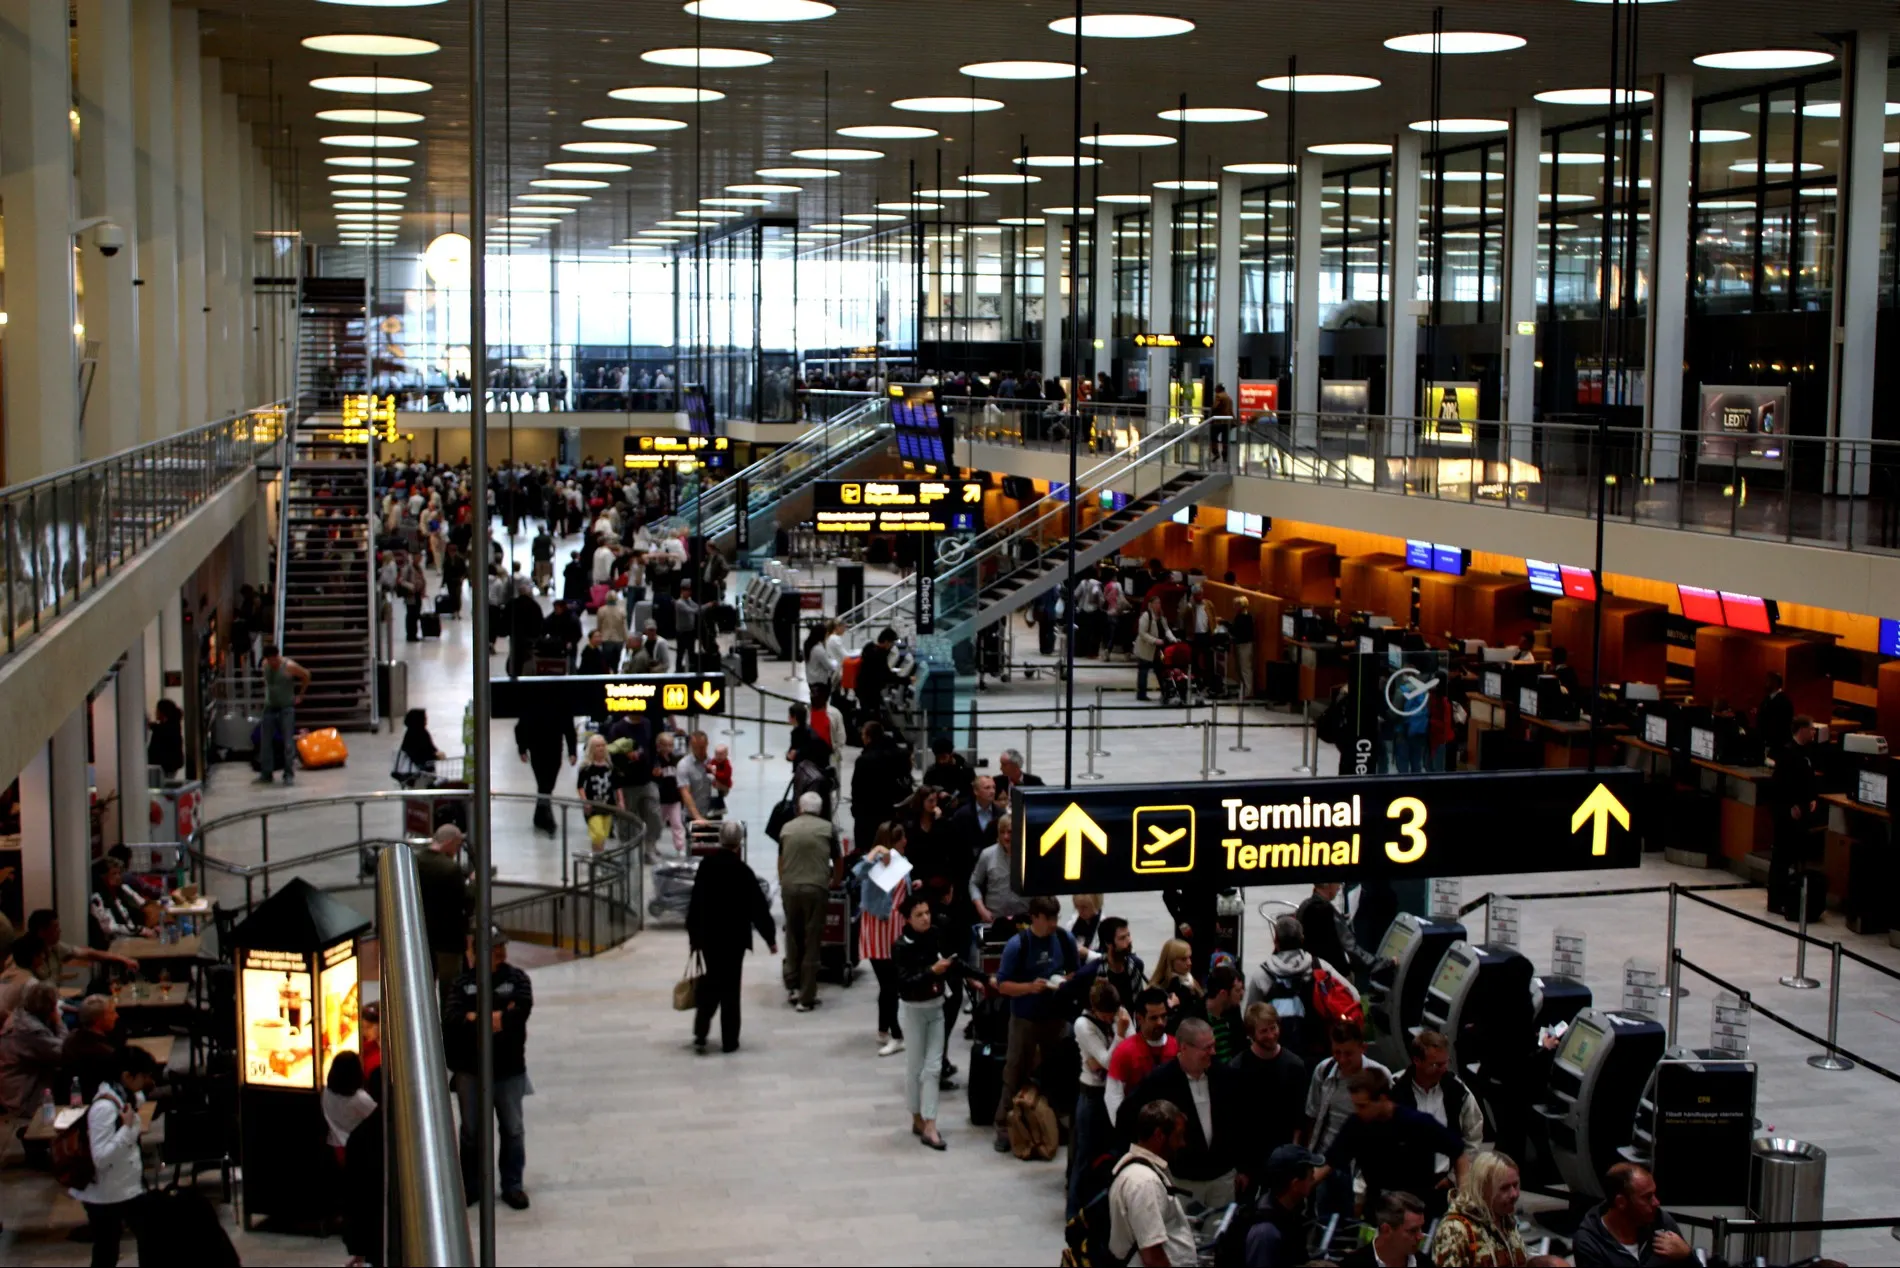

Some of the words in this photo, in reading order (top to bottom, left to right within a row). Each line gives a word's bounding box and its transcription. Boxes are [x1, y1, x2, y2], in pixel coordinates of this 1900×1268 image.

[921, 577, 932, 624] Check-in
[1222, 795, 1360, 831] Terminal
[1385, 797, 1428, 864] 3
[1222, 834, 1360, 870] Terminal
